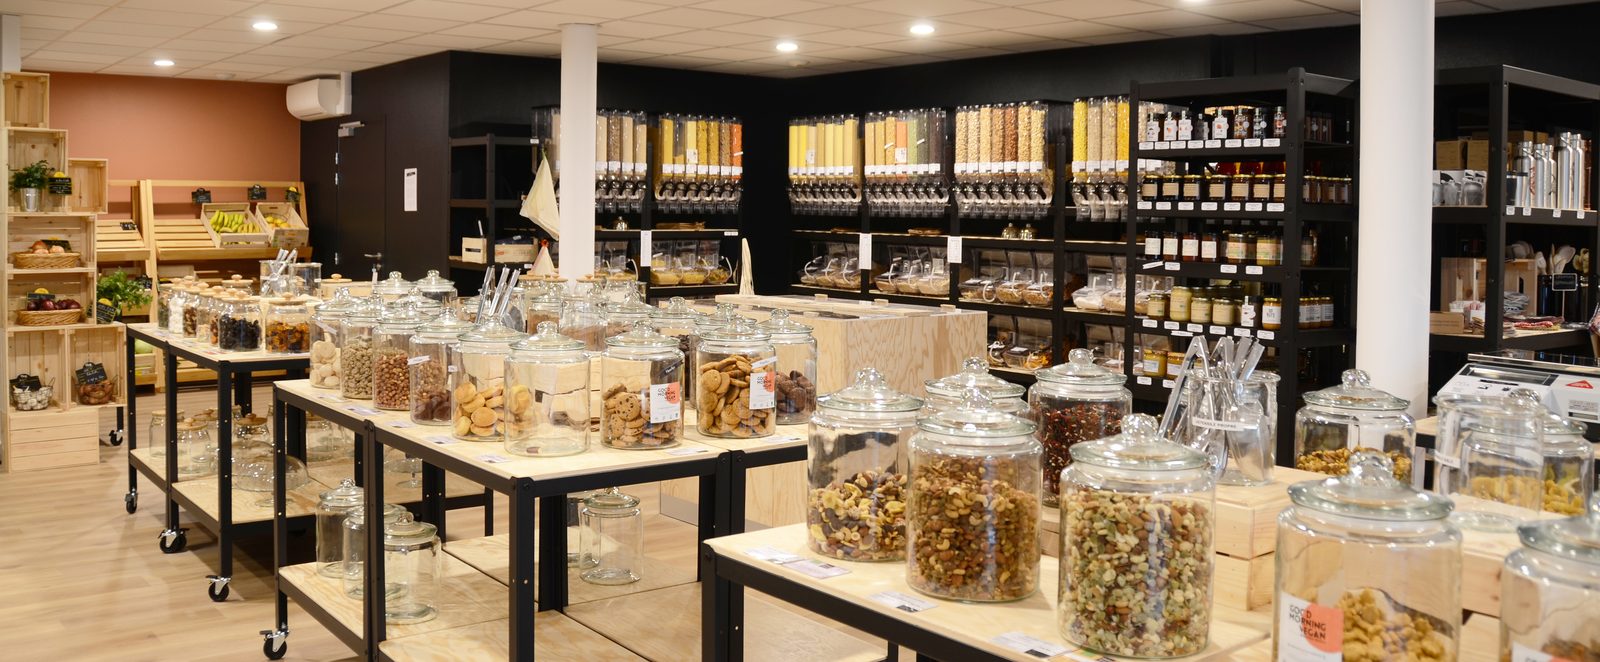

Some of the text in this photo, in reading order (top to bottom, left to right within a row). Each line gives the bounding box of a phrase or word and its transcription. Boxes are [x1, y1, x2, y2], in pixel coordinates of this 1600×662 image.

[1289, 605, 1312, 619] GOOD
[1289, 613, 1326, 631] MORNING
[1299, 625, 1326, 640] VEGAN
